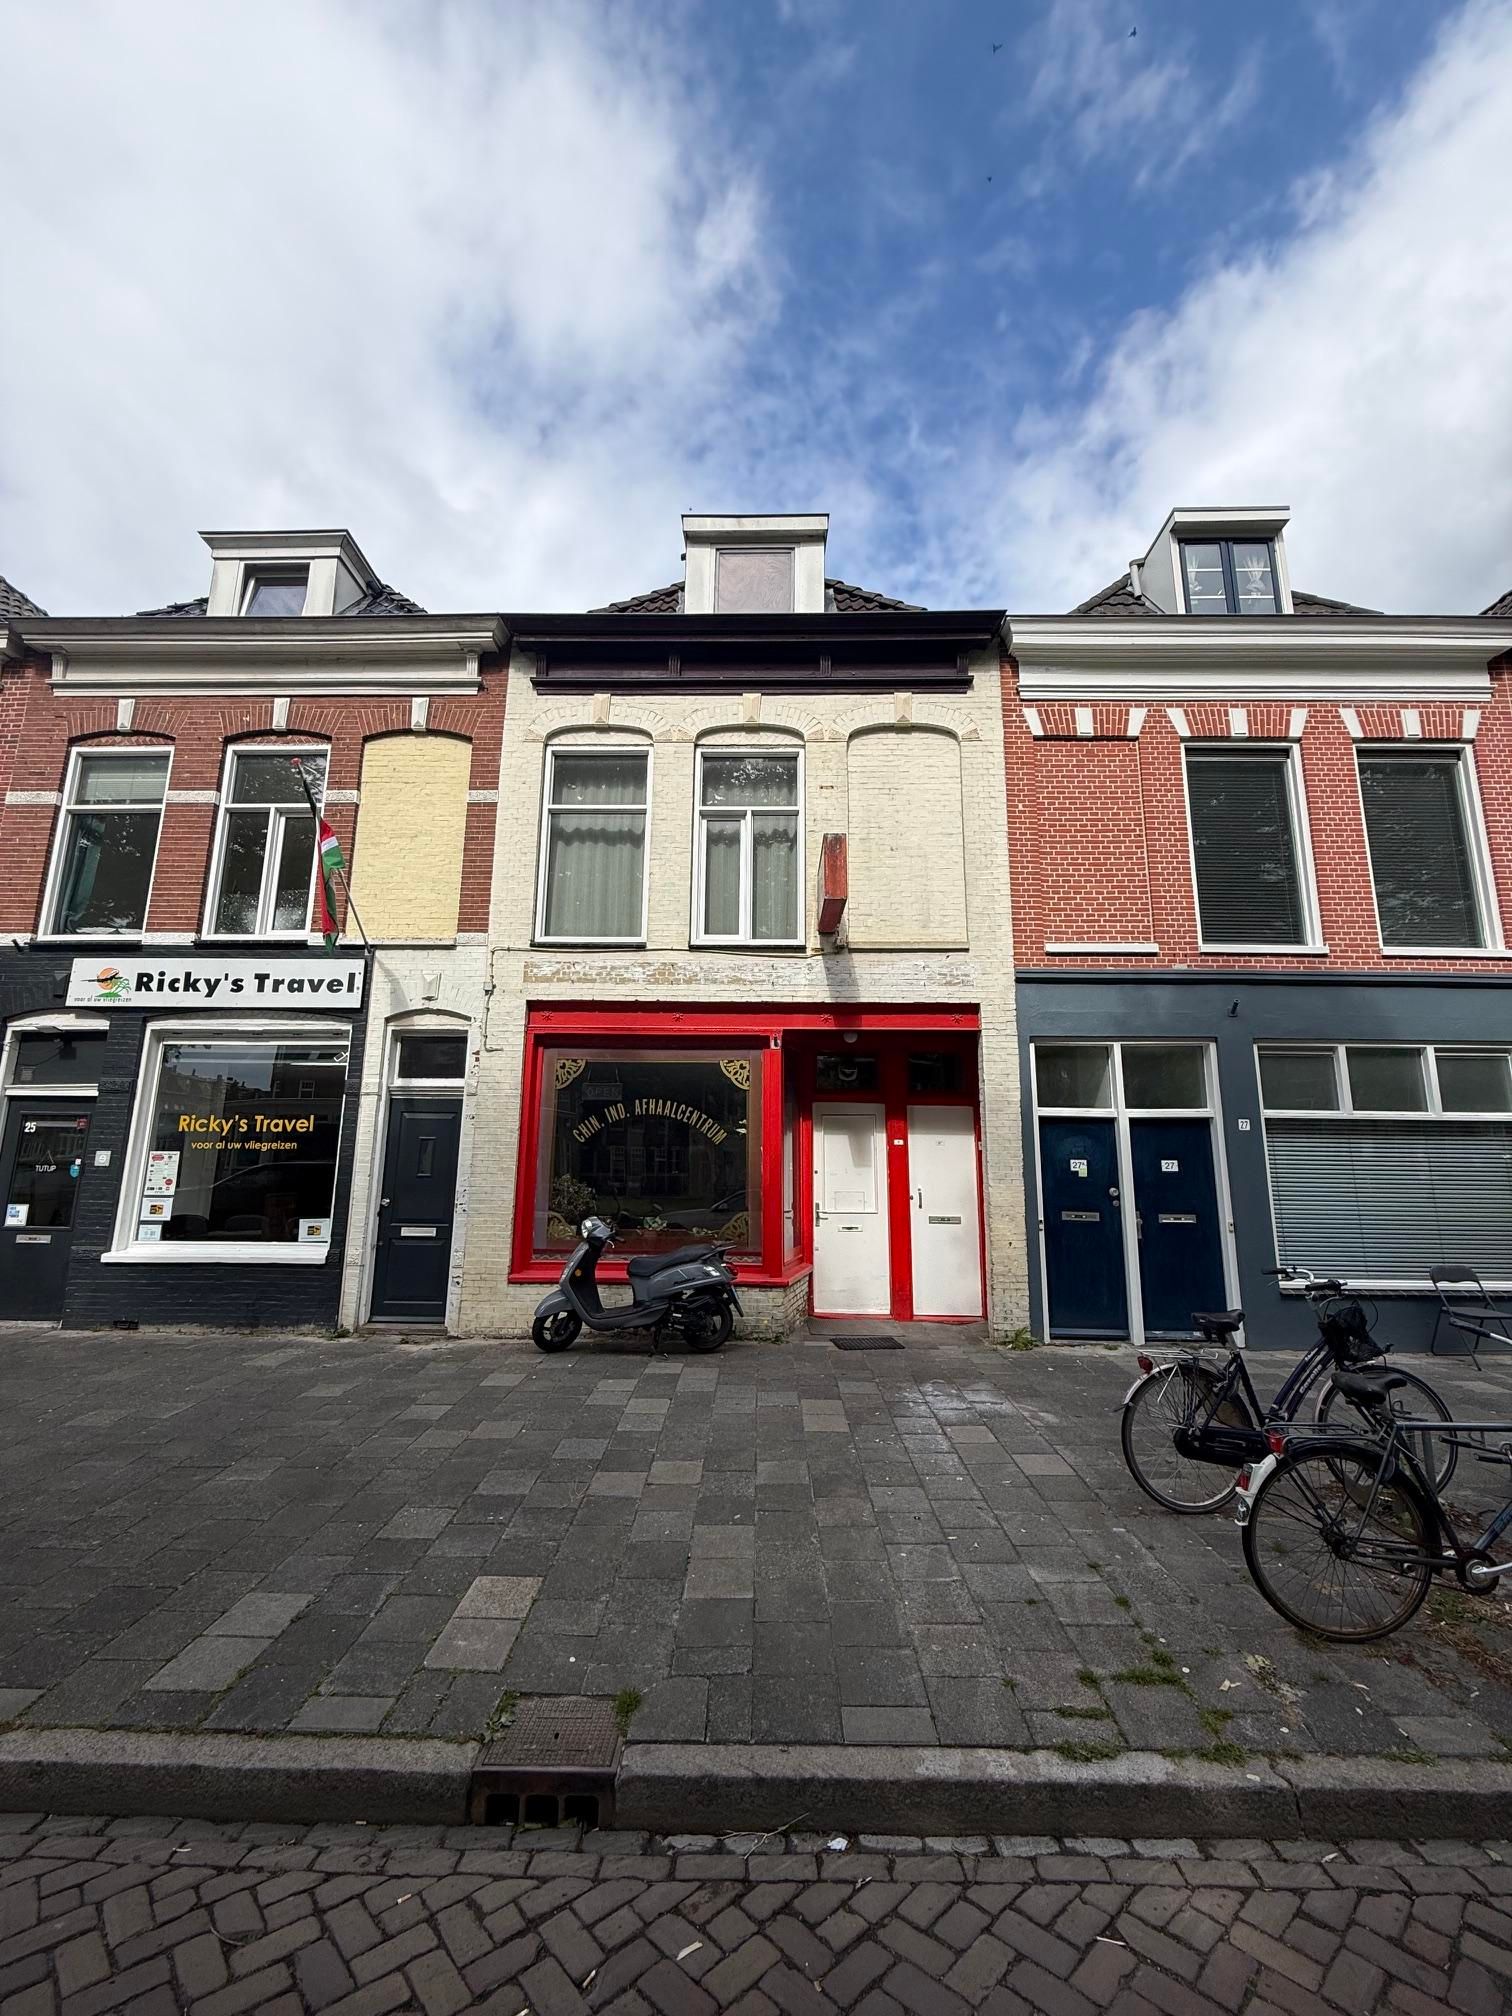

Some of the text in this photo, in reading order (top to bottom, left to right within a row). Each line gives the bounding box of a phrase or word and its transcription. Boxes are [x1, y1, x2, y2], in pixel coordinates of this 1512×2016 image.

[134, 970, 356, 998] Ricky's Travel
[24, 1121, 37, 1133] 25
[178, 1114, 315, 1136] Ricky's Travel
[572, 1099, 728, 1145] CHIN. IND. AFHAALCENTRUM
[1240, 1120, 1249, 1129] 27
[191, 1140, 298, 1152] voor al uw vliegreizen
[35, 1164, 57, 1173] TUTUP
